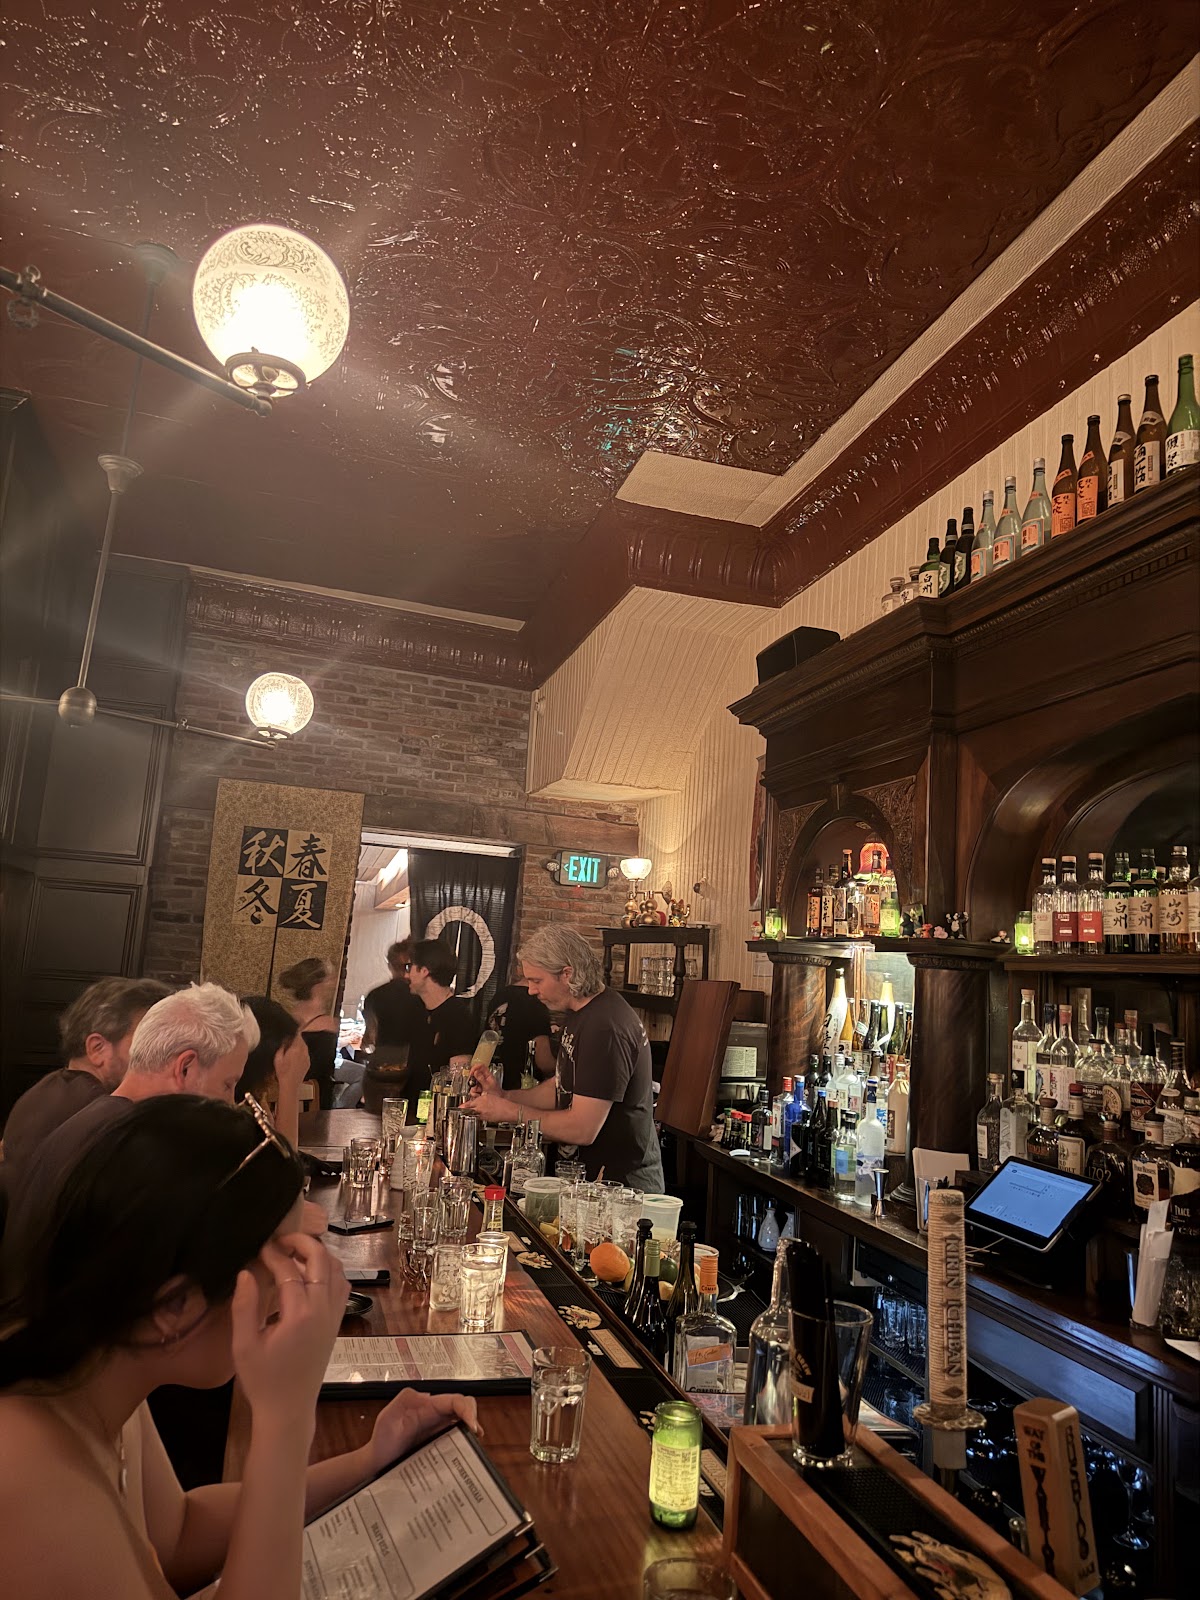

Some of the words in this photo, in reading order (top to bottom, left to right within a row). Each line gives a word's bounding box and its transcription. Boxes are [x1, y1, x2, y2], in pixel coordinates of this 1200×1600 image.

[568, 856, 601, 882] EXIT
[1114, 901, 1128, 929] 白州
[1138, 900, 1153, 929] 白州
[944, 1238, 960, 1290] KIRIN
[945, 1300, 962, 1378] ICHIBAN
